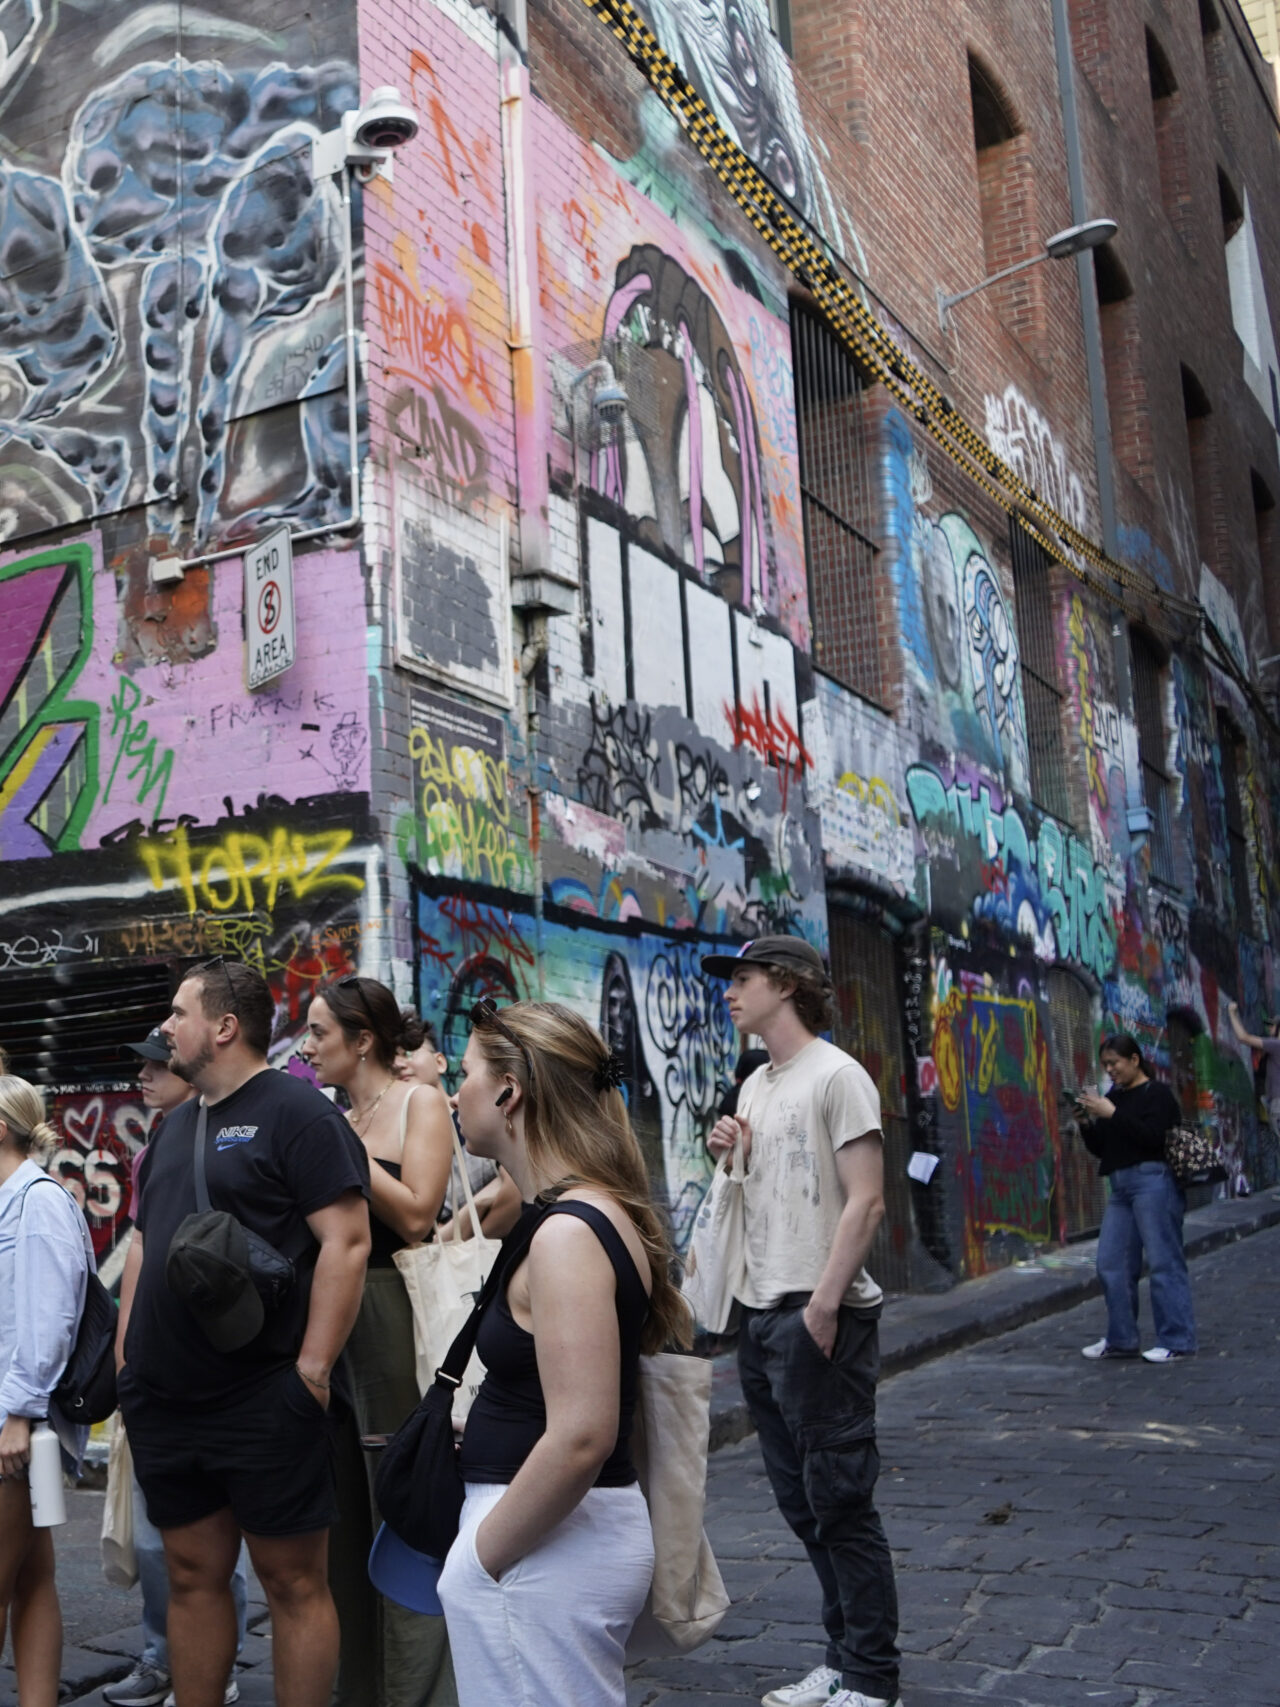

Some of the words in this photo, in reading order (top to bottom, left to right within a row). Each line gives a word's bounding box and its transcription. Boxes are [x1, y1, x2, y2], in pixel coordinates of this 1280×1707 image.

[256, 547, 279, 581] END
[255, 634, 287, 669] AREA
[216, 1125, 259, 1138] NIKE
